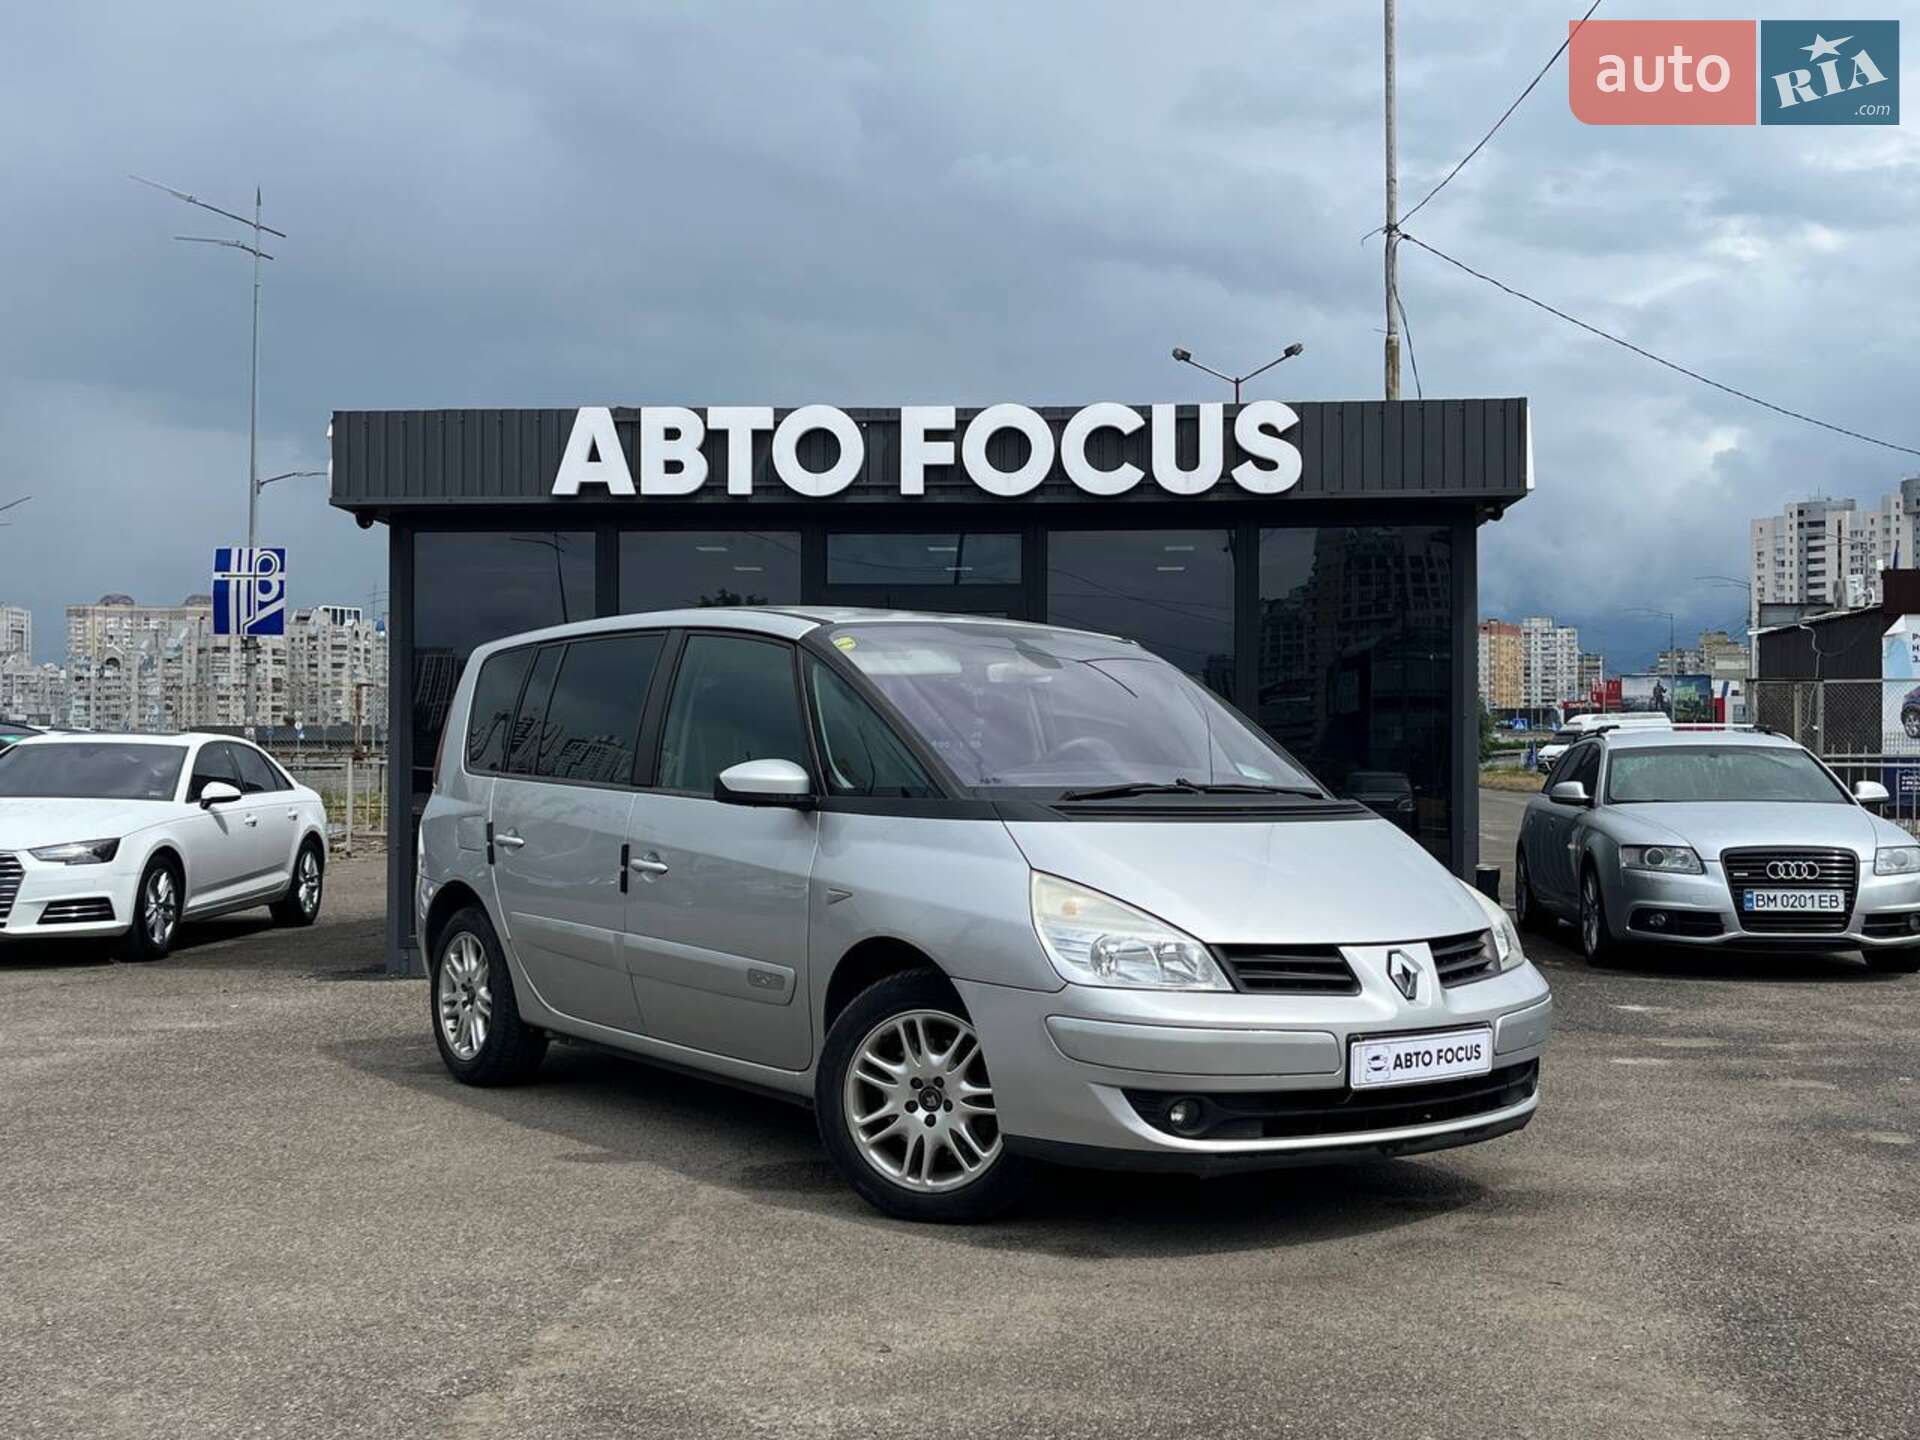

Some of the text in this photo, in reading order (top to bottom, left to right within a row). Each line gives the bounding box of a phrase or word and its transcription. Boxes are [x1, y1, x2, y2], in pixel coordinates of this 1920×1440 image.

[551, 400, 1303, 497] АВТО FOCUS
[1755, 893, 1840, 909] BM 0201 EB
[1392, 1044, 1482, 1070] АВТО FOCUS
